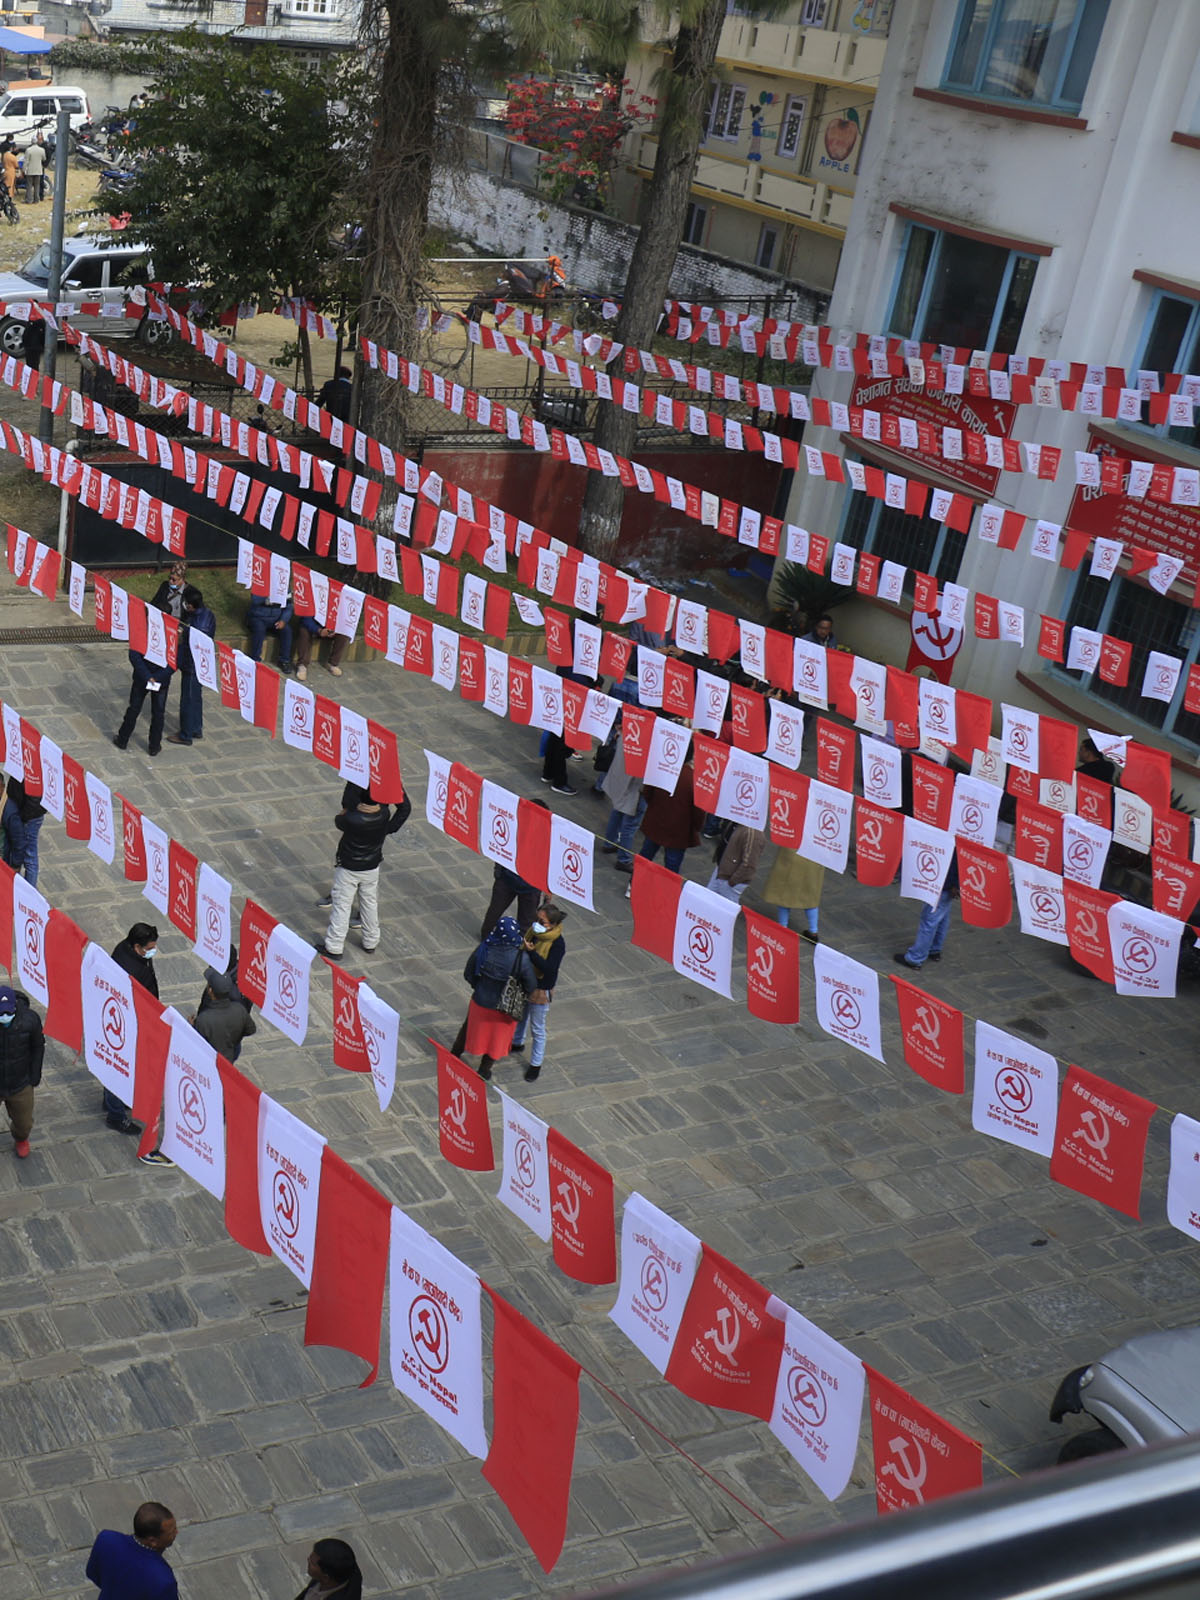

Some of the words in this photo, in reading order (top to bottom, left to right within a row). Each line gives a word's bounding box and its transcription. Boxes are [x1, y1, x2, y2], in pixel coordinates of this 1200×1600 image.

[819, 156, 850, 173] APPLE
[856, 379, 893, 406] पेशागत
[988, 1103, 1011, 1120] Y.C.L.
[1013, 1112, 1039, 1130] Nepal
[1088, 1151, 1115, 1177] Nepal
[286, 1238, 305, 1264] Nepal
[402, 1348, 427, 1379] Y.C.L.
[429, 1373, 459, 1404] Nepal
[714, 1360, 751, 1378] Nepal
